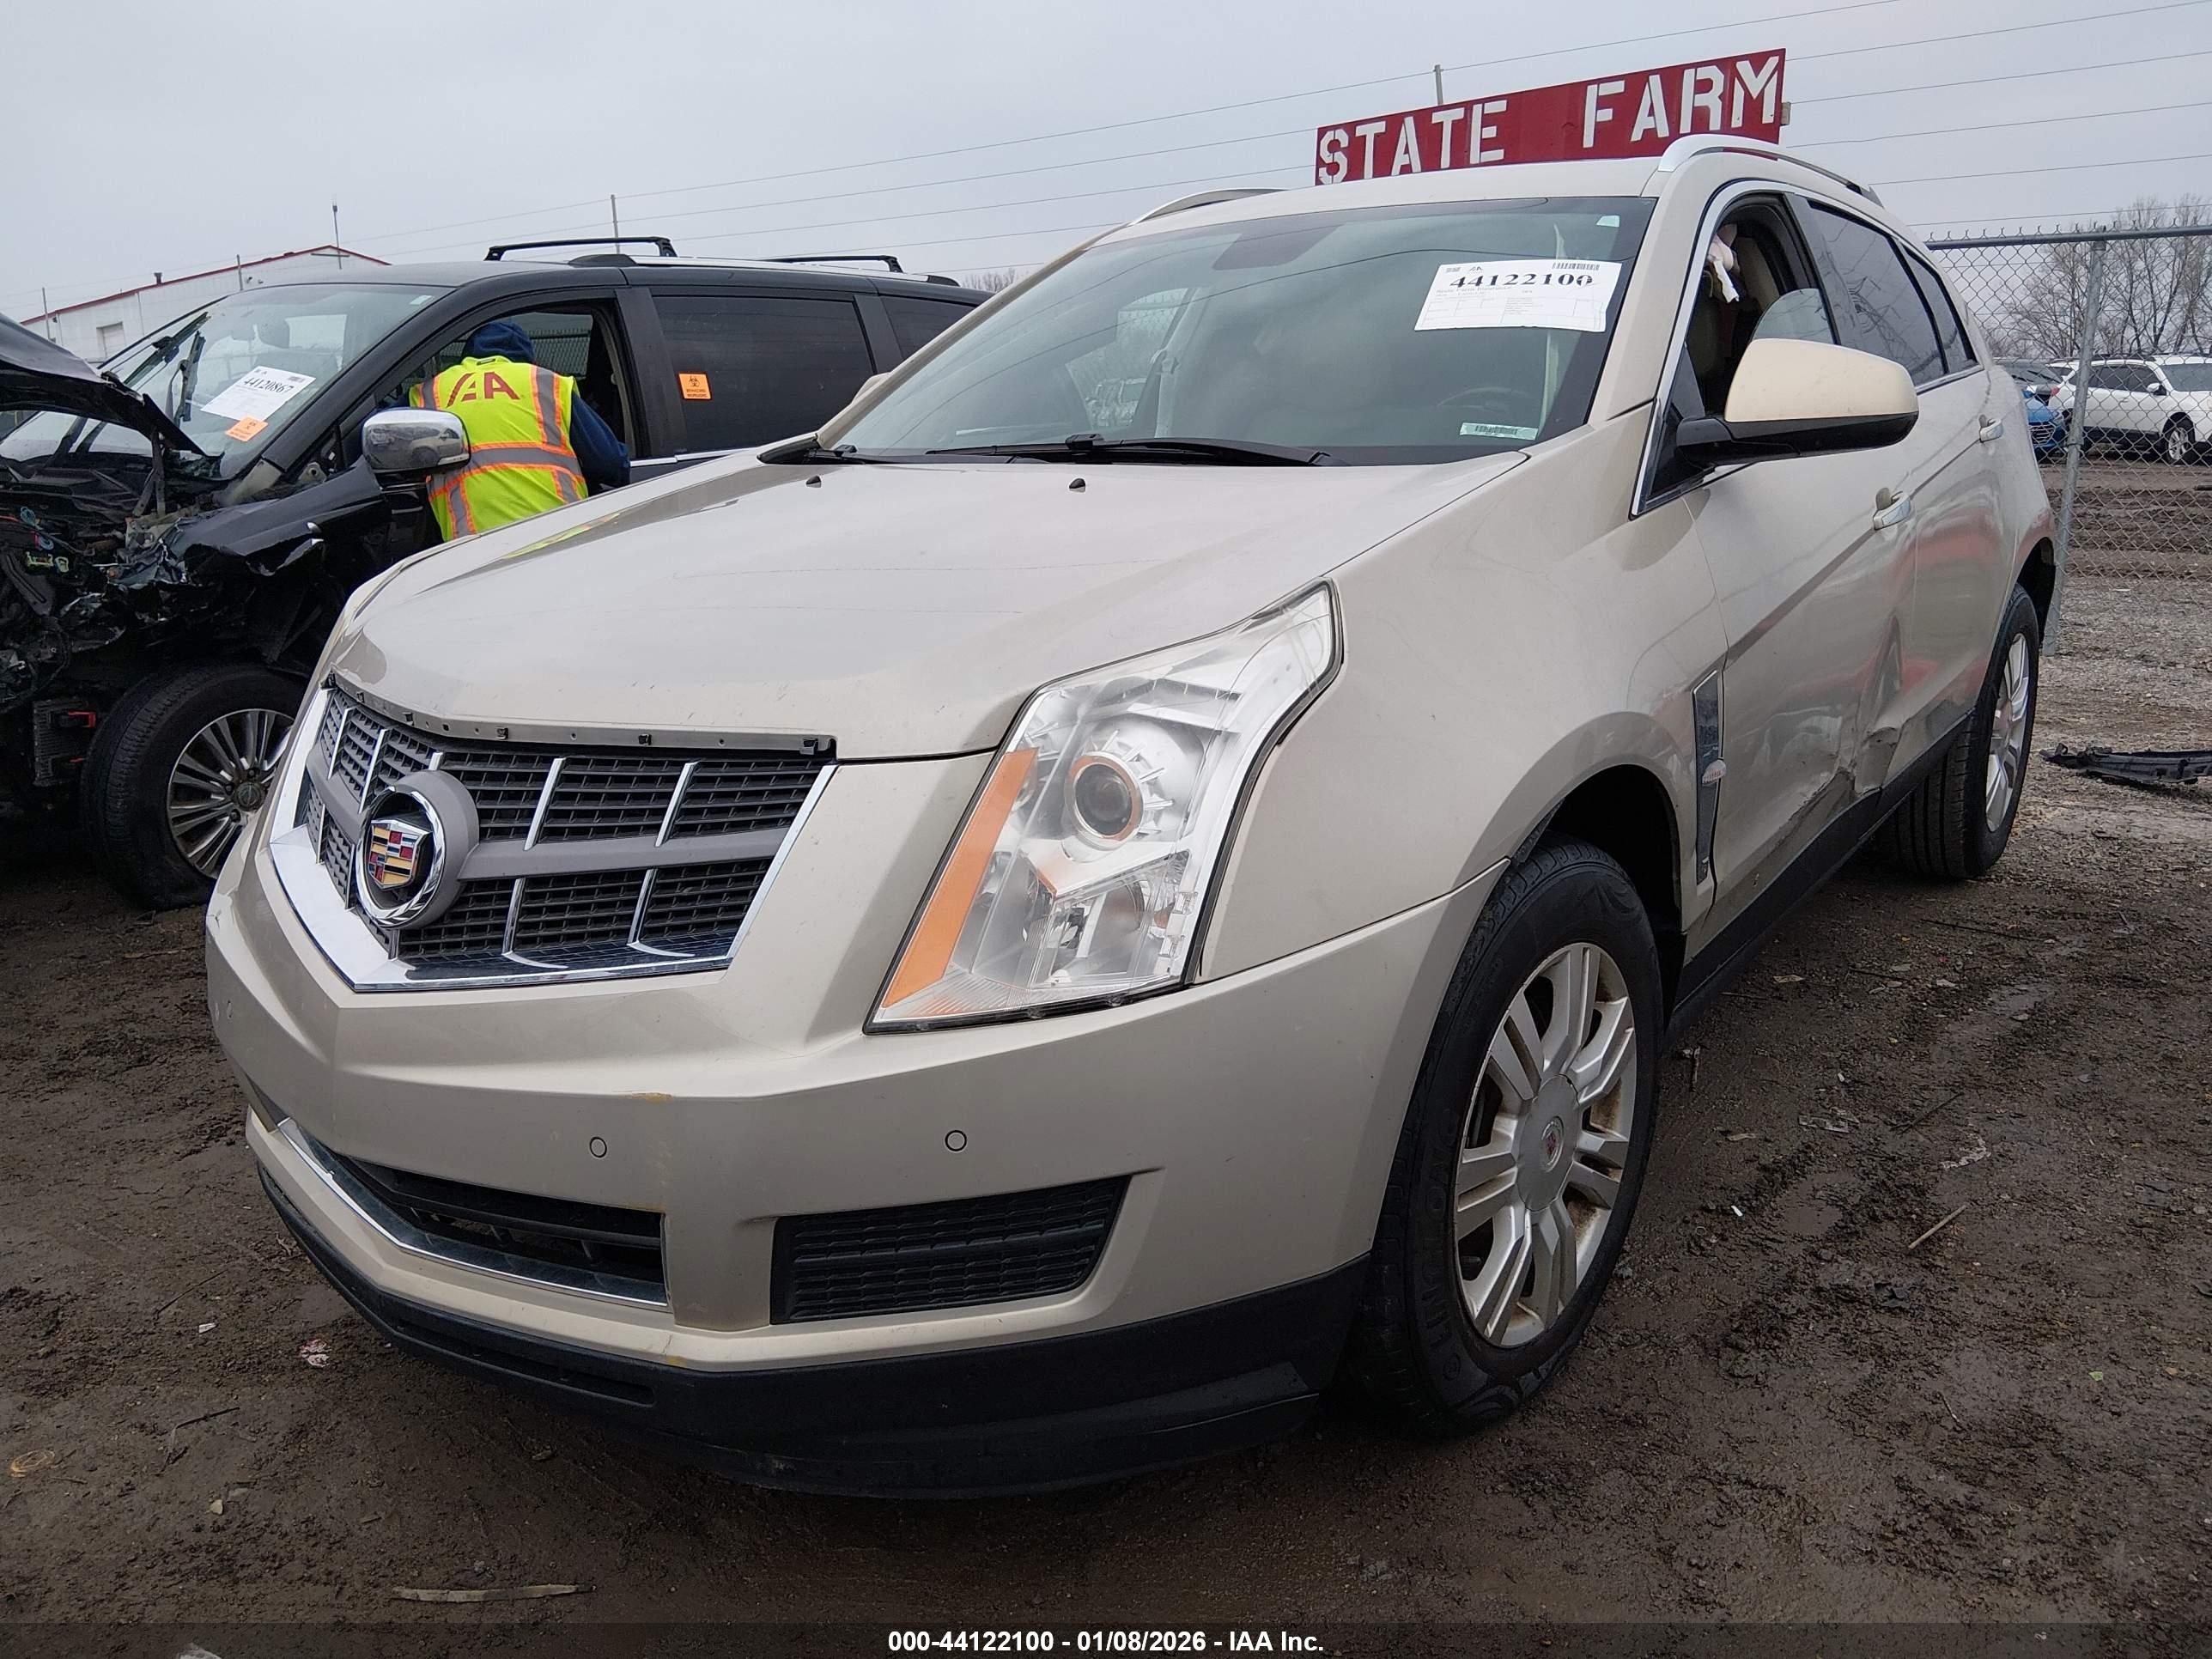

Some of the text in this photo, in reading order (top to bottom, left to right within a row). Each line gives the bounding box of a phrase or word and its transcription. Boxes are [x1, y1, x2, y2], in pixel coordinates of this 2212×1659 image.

[1318, 55, 1780, 185] STATE FARM
[244, 376, 295, 393] 44120867
